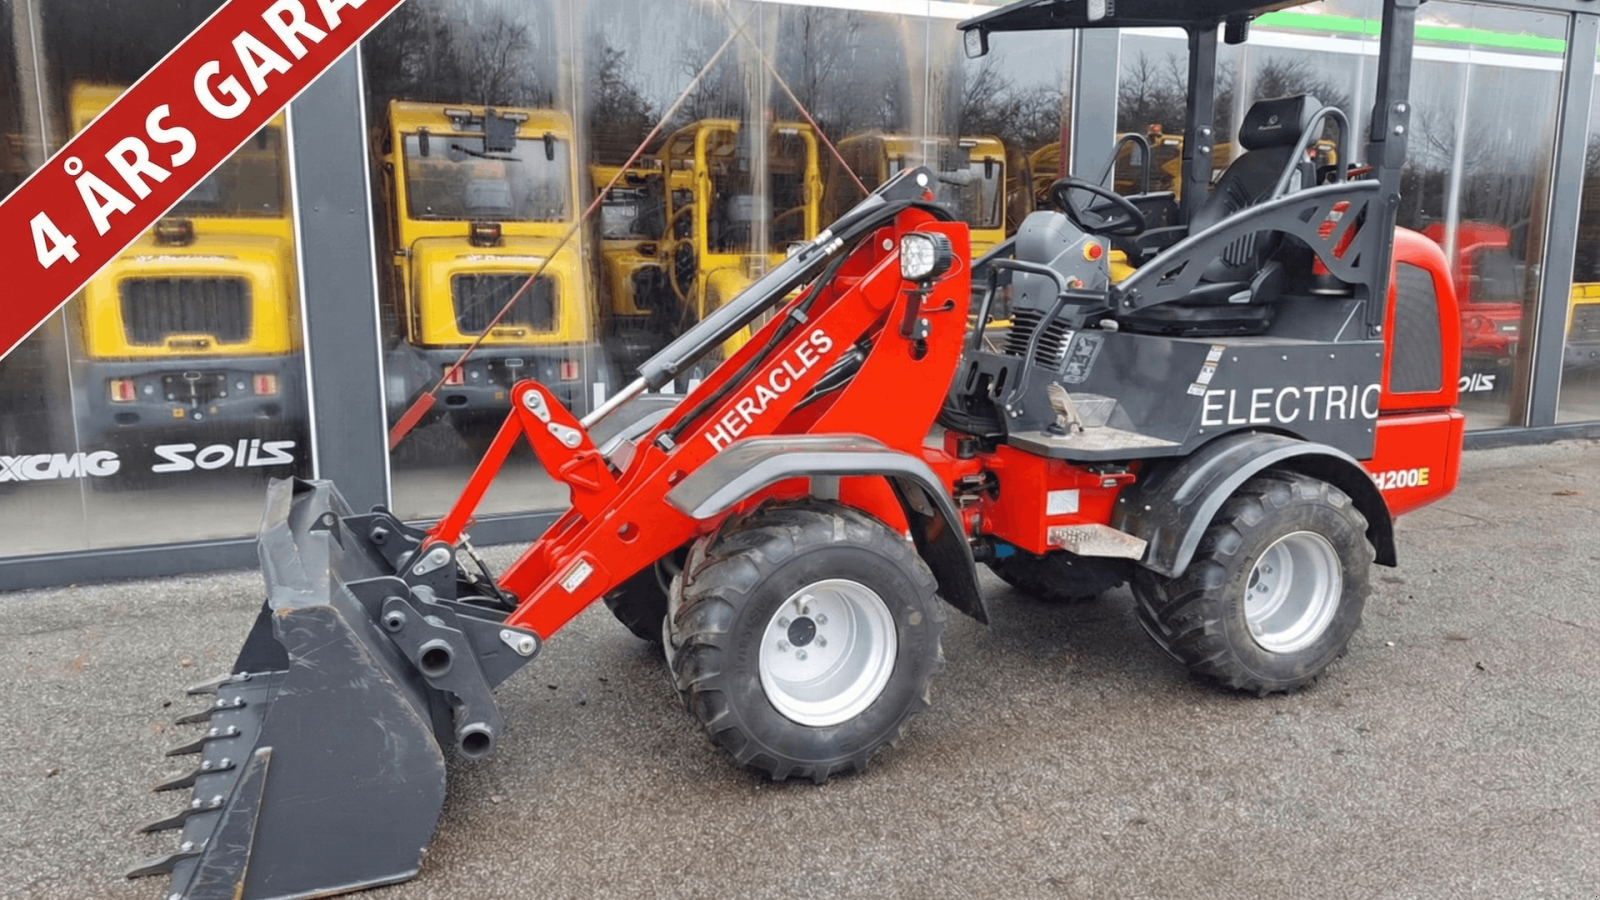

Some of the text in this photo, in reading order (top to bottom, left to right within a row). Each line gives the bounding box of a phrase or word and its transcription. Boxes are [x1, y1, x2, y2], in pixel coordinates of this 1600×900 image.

[705, 329, 833, 452] HERACLES
[1201, 384, 1381, 426] ELECTRIC
[0, 450, 120, 482] XCMG
